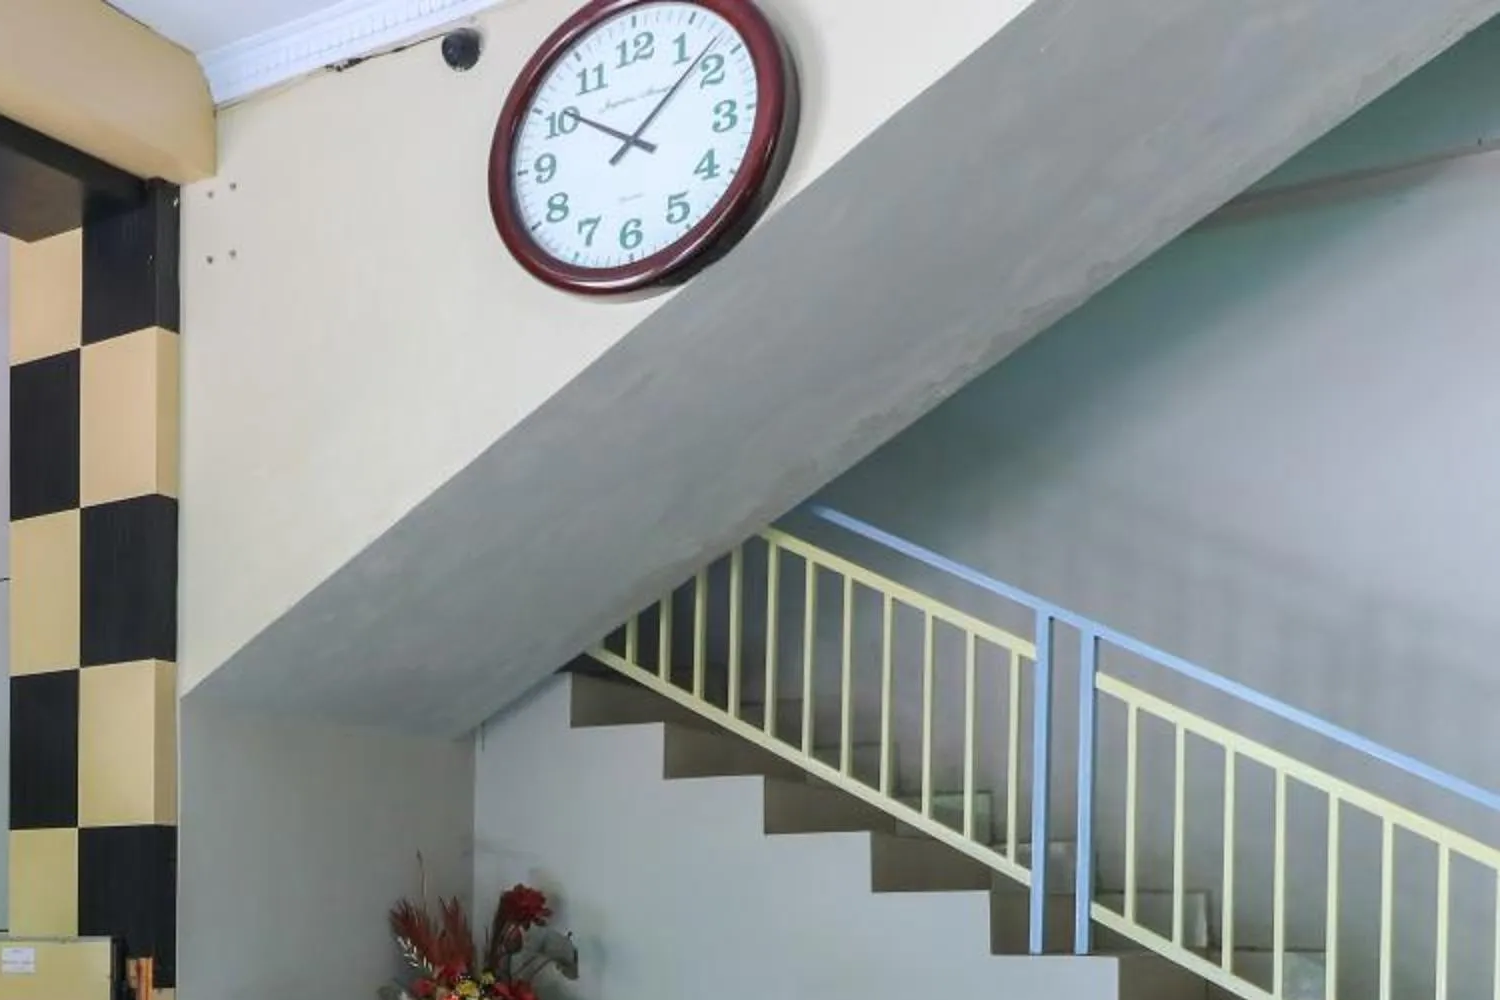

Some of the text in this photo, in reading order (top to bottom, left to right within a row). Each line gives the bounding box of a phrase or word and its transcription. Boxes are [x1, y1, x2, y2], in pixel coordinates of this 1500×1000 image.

[615, 31, 655, 69] 12
[672, 32, 691, 64] 1
[575, 63, 608, 96] 11
[699, 53, 726, 88] 2
[544, 105, 580, 140] 10
[712, 99, 738, 133] 3
[534, 153, 557, 184] 9
[694, 149, 719, 181] 4
[546, 192, 569, 224] 8
[665, 192, 691, 225] 5
[577, 215, 601, 248] 7
[619, 218, 643, 250] 6
